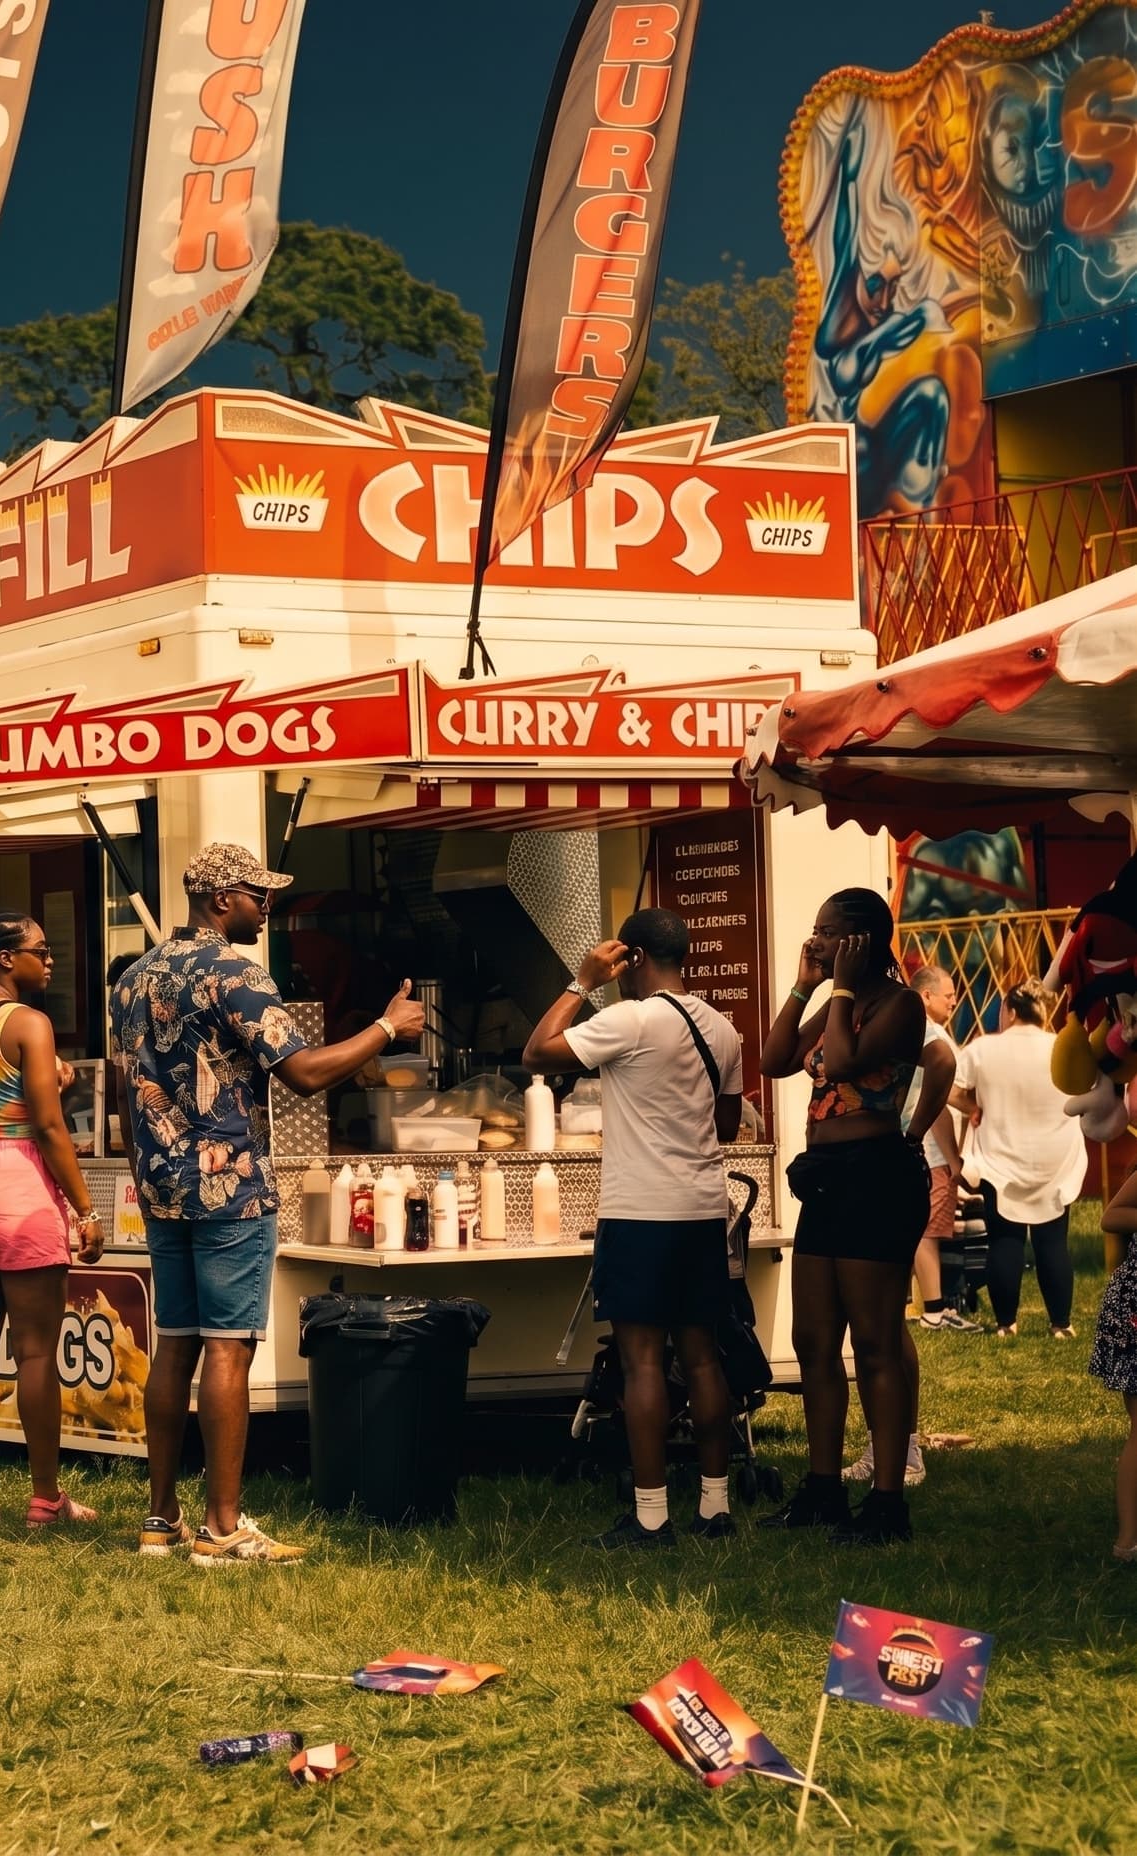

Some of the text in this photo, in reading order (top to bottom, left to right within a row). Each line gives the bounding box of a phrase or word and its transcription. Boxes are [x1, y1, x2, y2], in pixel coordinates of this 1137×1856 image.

[544, 3, 680, 440] BURGERS
[252, 502, 310, 524] CHIPS
[358, 461, 724, 577] CHIPS
[761, 527, 814, 548] CHIPS
[183, 705, 336, 762] DOGS
[437, 698, 600, 746] CURRY
[617, 701, 653, 748] &
